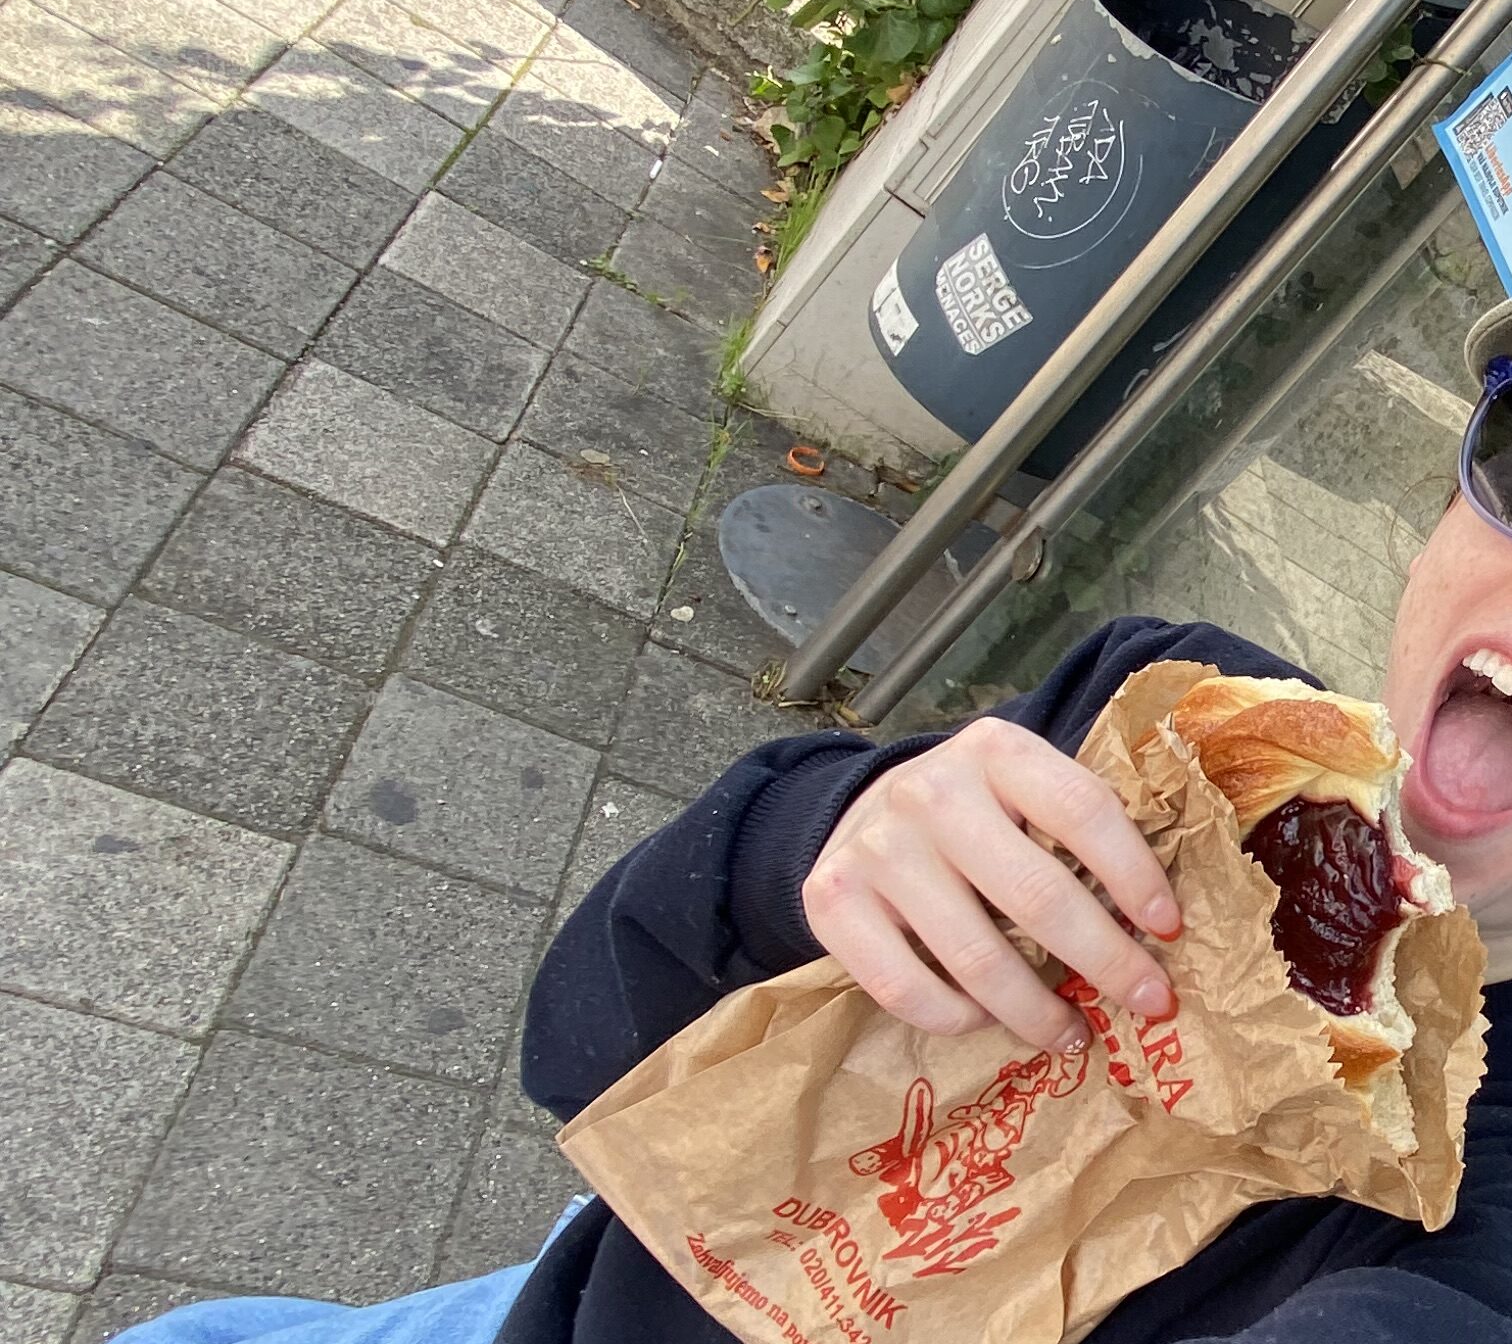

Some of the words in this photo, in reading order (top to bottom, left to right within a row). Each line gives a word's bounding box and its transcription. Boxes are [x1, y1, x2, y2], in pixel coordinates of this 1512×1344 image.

[935, 270, 982, 356] MENACES
[944, 253, 1006, 344] NORKS
[966, 239, 1031, 330] SERGE
[685, 1231, 773, 1312] Zahvaljujemo
[766, 1301, 789, 1329] na
[770, 1194, 909, 1332] DUBROVNIK
